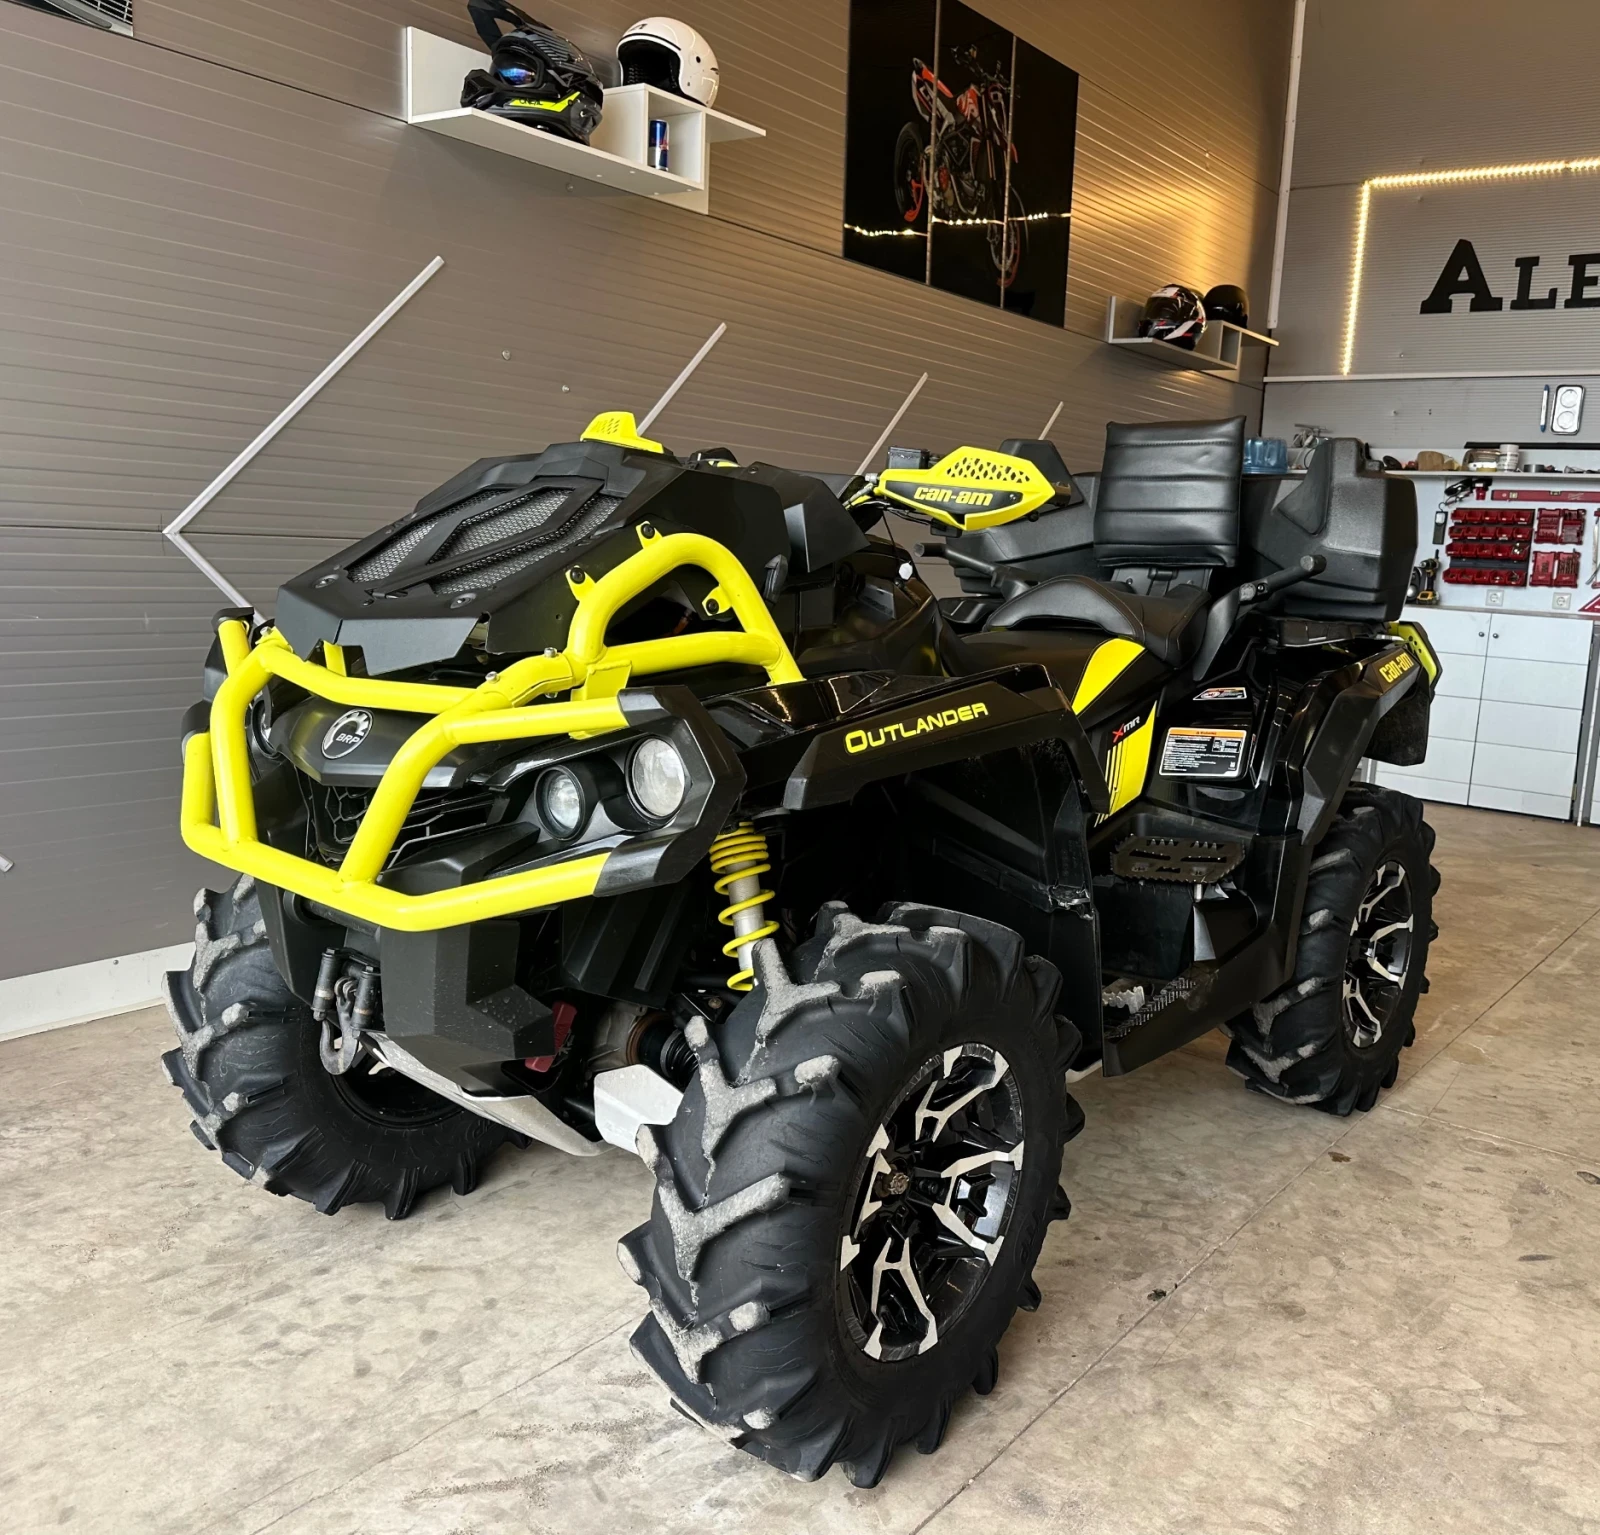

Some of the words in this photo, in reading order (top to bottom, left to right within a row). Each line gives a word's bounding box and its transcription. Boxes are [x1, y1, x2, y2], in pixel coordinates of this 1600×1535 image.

[914, 486, 994, 506] can-am
[1379, 652, 1414, 683] can-am
[335, 732, 361, 745] BRP
[845, 702, 989, 754] OUTLANDER
